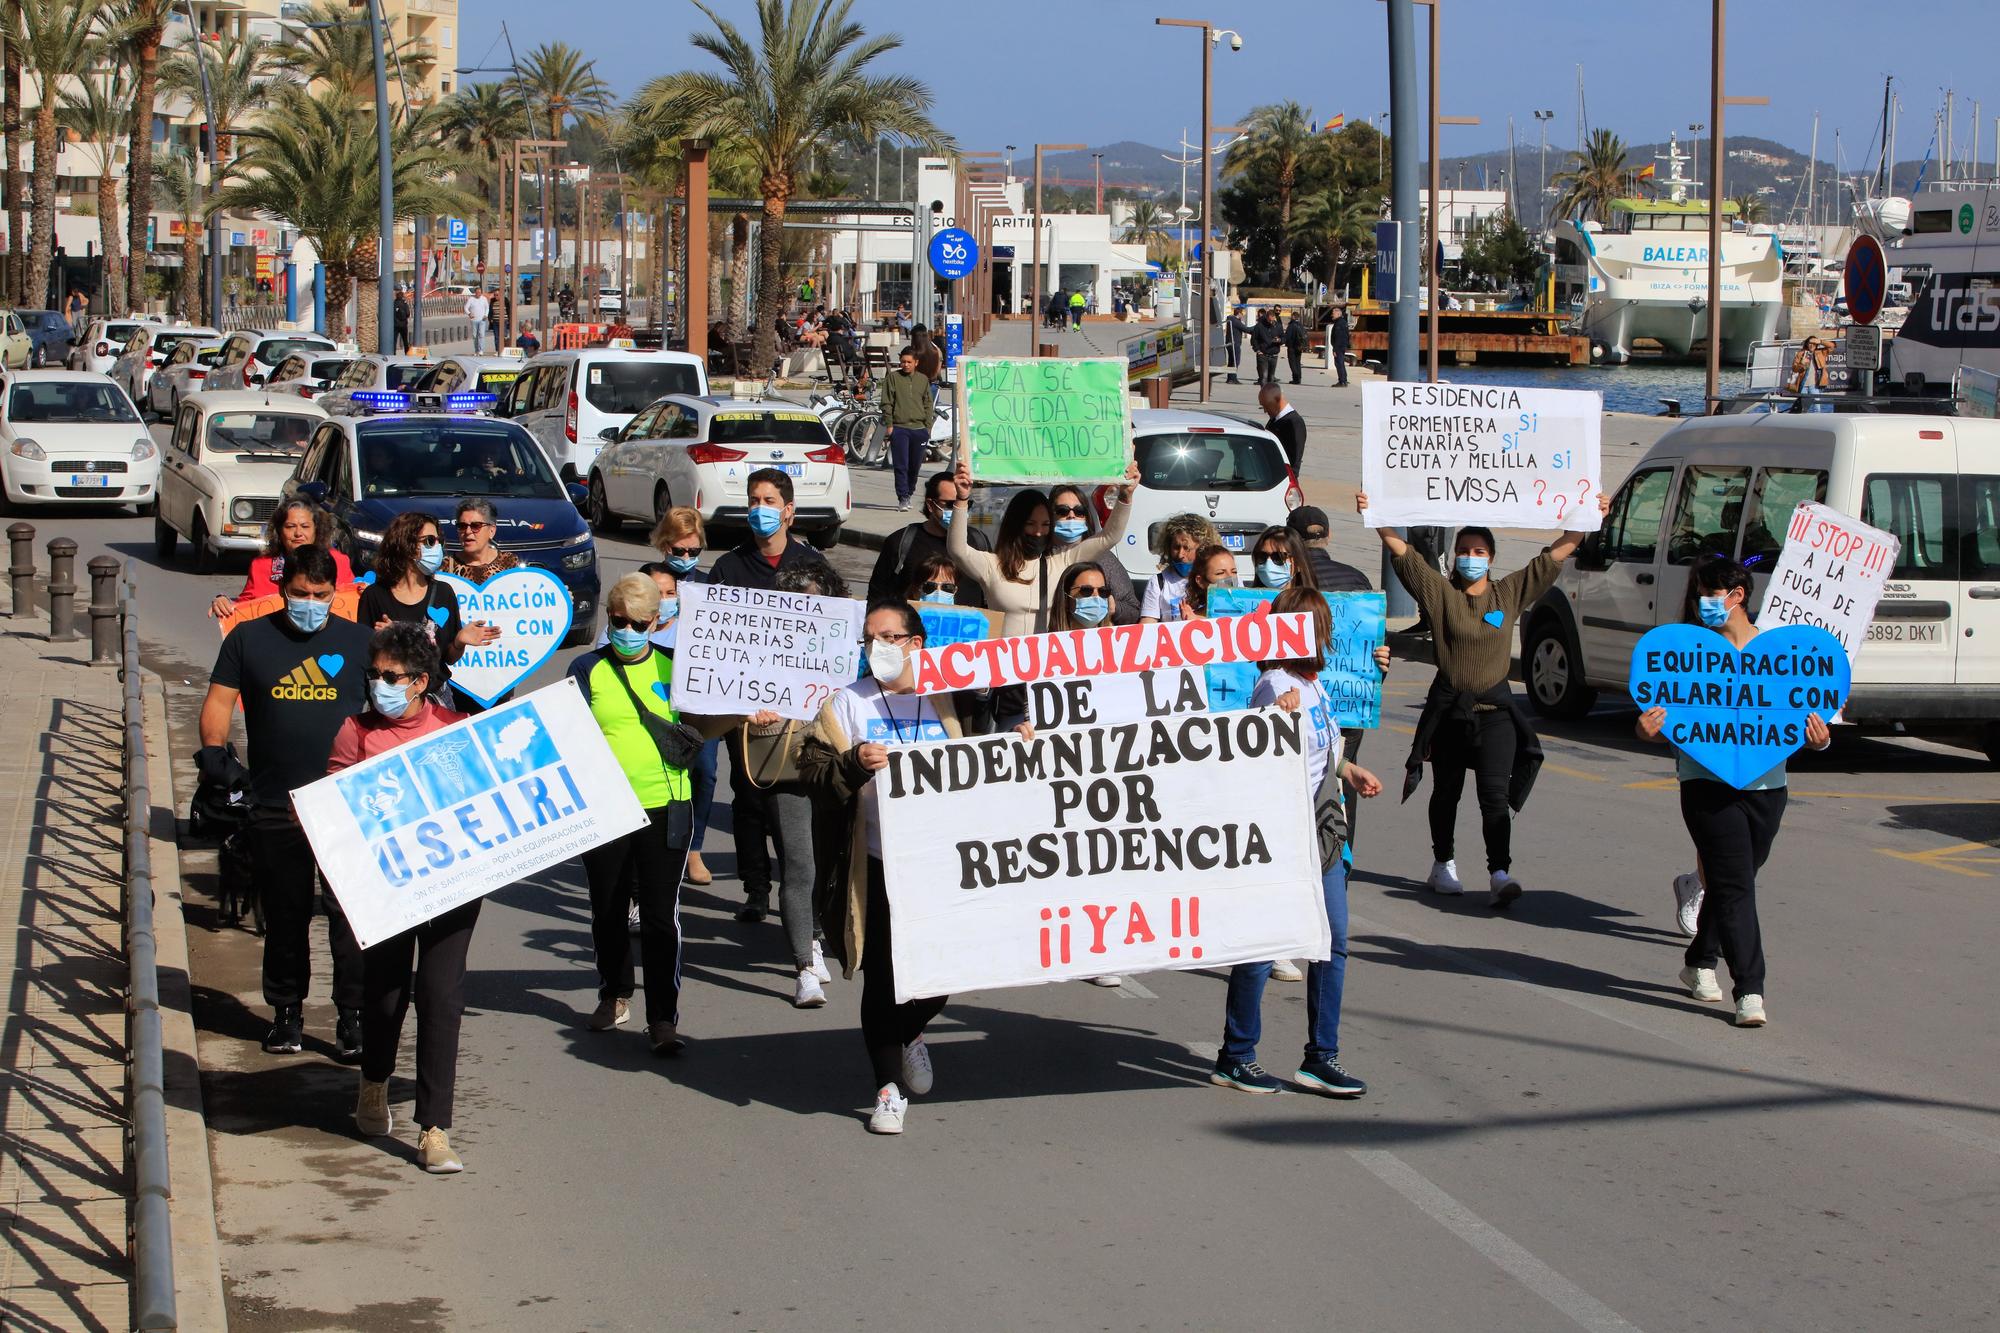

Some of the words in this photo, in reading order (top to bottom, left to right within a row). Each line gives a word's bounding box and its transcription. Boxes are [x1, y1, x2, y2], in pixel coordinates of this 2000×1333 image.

[1377, 250, 1397, 274] TAXI
[1643, 247, 1725, 263] BALEAR
[1684, 283, 1740, 291] FORMTERA
[973, 365, 1026, 393] IBIZA
[1043, 366, 1073, 392] SE
[991, 394, 1069, 424] QUEDA
[1083, 393, 1122, 421] SIN
[1392, 386, 1522, 410] RESIDENCIA
[1389, 415, 1497, 434] FORMENTERA
[1386, 451, 1442, 470] CEUTA
[1468, 448, 1538, 470] MELILLA
[729, 468, 736, 476] A
[1127, 534, 1136, 545] C
[1803, 551, 1814, 569] A
[1825, 559, 1846, 582] LA
[1782, 569, 1823, 601] FUGA
[1832, 594, 1855, 617] DE
[516, 619, 554, 636] CON
[695, 609, 818, 636] FORMENTERA
[1352, 620, 1362, 634] Y
[1909, 625, 1937, 641] DKY
[688, 644, 751, 665] CEUTA
[914, 600, 1311, 695] ACTUALIZACIÓN
[271, 683, 338, 700] adidas
[1031, 679, 1098, 732] DE
[1138, 668, 1208, 718] LA
[1788, 686, 1840, 711] CON
[886, 705, 1303, 799] INDEMNIZACIÓN
[1049, 773, 1162, 829] POR
[492, 851, 512, 866] POR
[512, 847, 524, 860] LA
[523, 823, 584, 855] EQUIPARACIÓN
[583, 816, 597, 829] DE
[506, 865, 519, 879] LA
[517, 844, 566, 873] RESIDENCIA
[565, 838, 579, 852] EN
[578, 831, 601, 848] IBIZA
[955, 822, 1273, 890] RESIDENCIA
